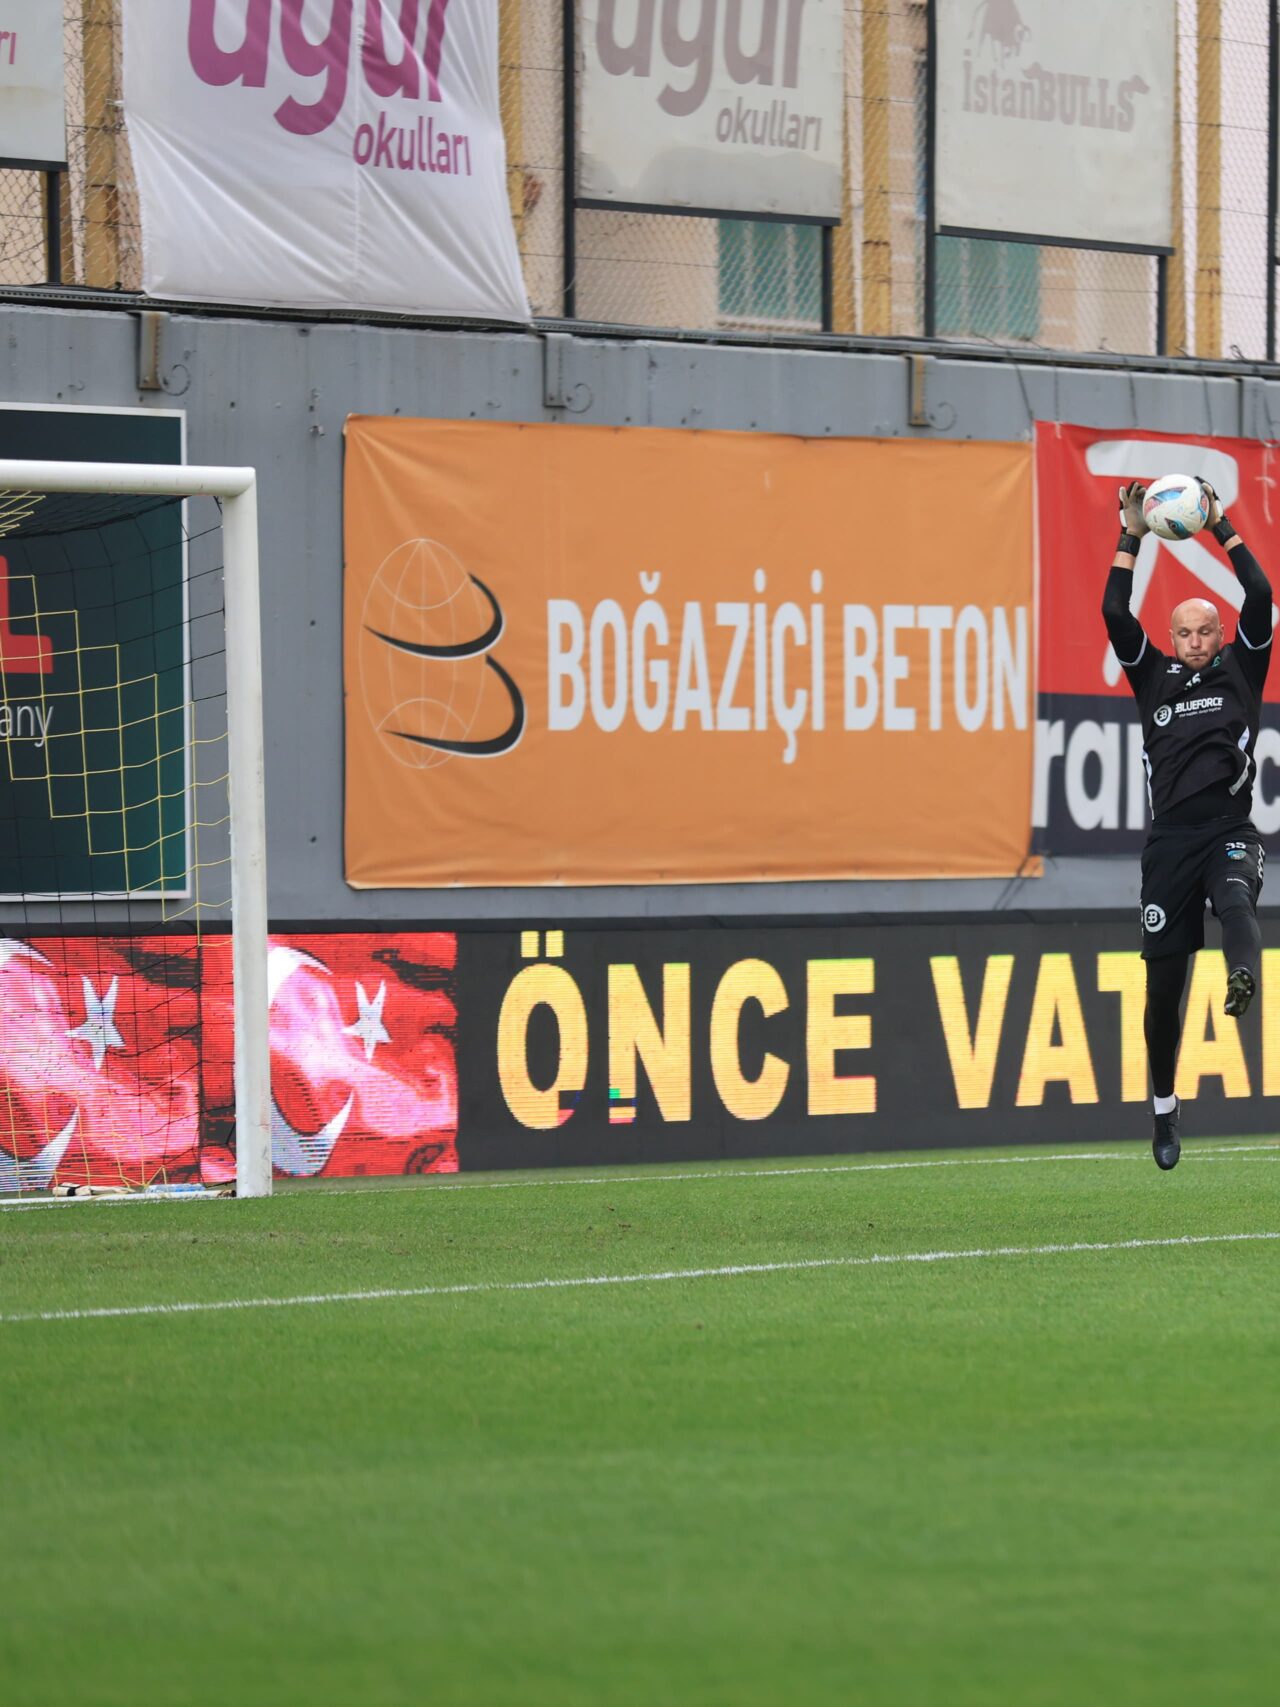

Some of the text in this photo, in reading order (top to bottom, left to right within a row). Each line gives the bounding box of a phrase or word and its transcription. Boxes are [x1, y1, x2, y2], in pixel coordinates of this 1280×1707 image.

[353, 111, 472, 177] okulları
[716, 96, 823, 151] okulları
[547, 567, 1028, 765] BOĞAZİÇİ BETON
[497, 930, 877, 1130] ÖNCE
